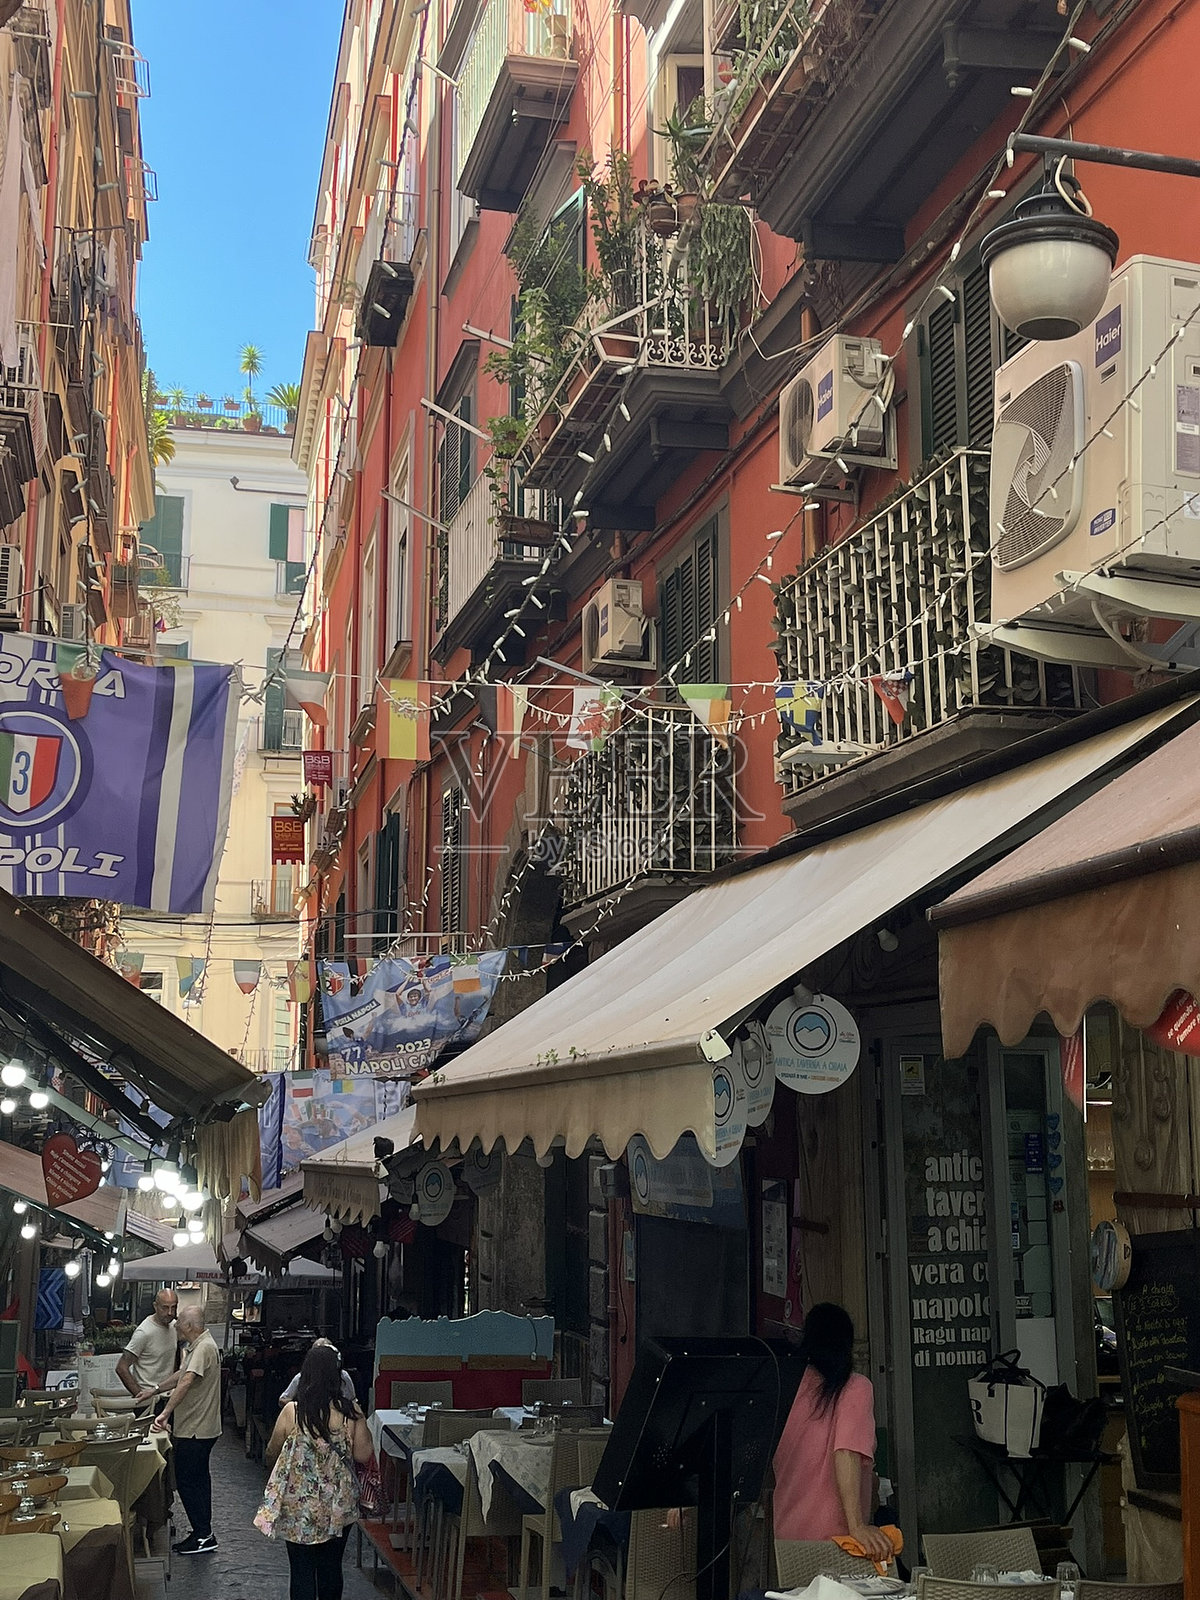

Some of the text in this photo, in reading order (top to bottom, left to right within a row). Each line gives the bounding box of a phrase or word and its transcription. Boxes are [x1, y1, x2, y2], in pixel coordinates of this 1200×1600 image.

[1096, 324, 1121, 352] Haier
[0, 654, 126, 698] ORA
[305, 755, 330, 765] B&B
[12, 751, 31, 796] 3
[274, 820, 303, 833] B&B
[351, 1001, 378, 1020] NAPOLI
[341, 1046, 361, 1061] 77
[396, 1038, 431, 1054] 2023
[345, 1058, 406, 1075] NAPOLI
[927, 1226, 943, 1252] a
[911, 1262, 965, 1286] vera
[914, 1349, 988, 1368] di nonna
